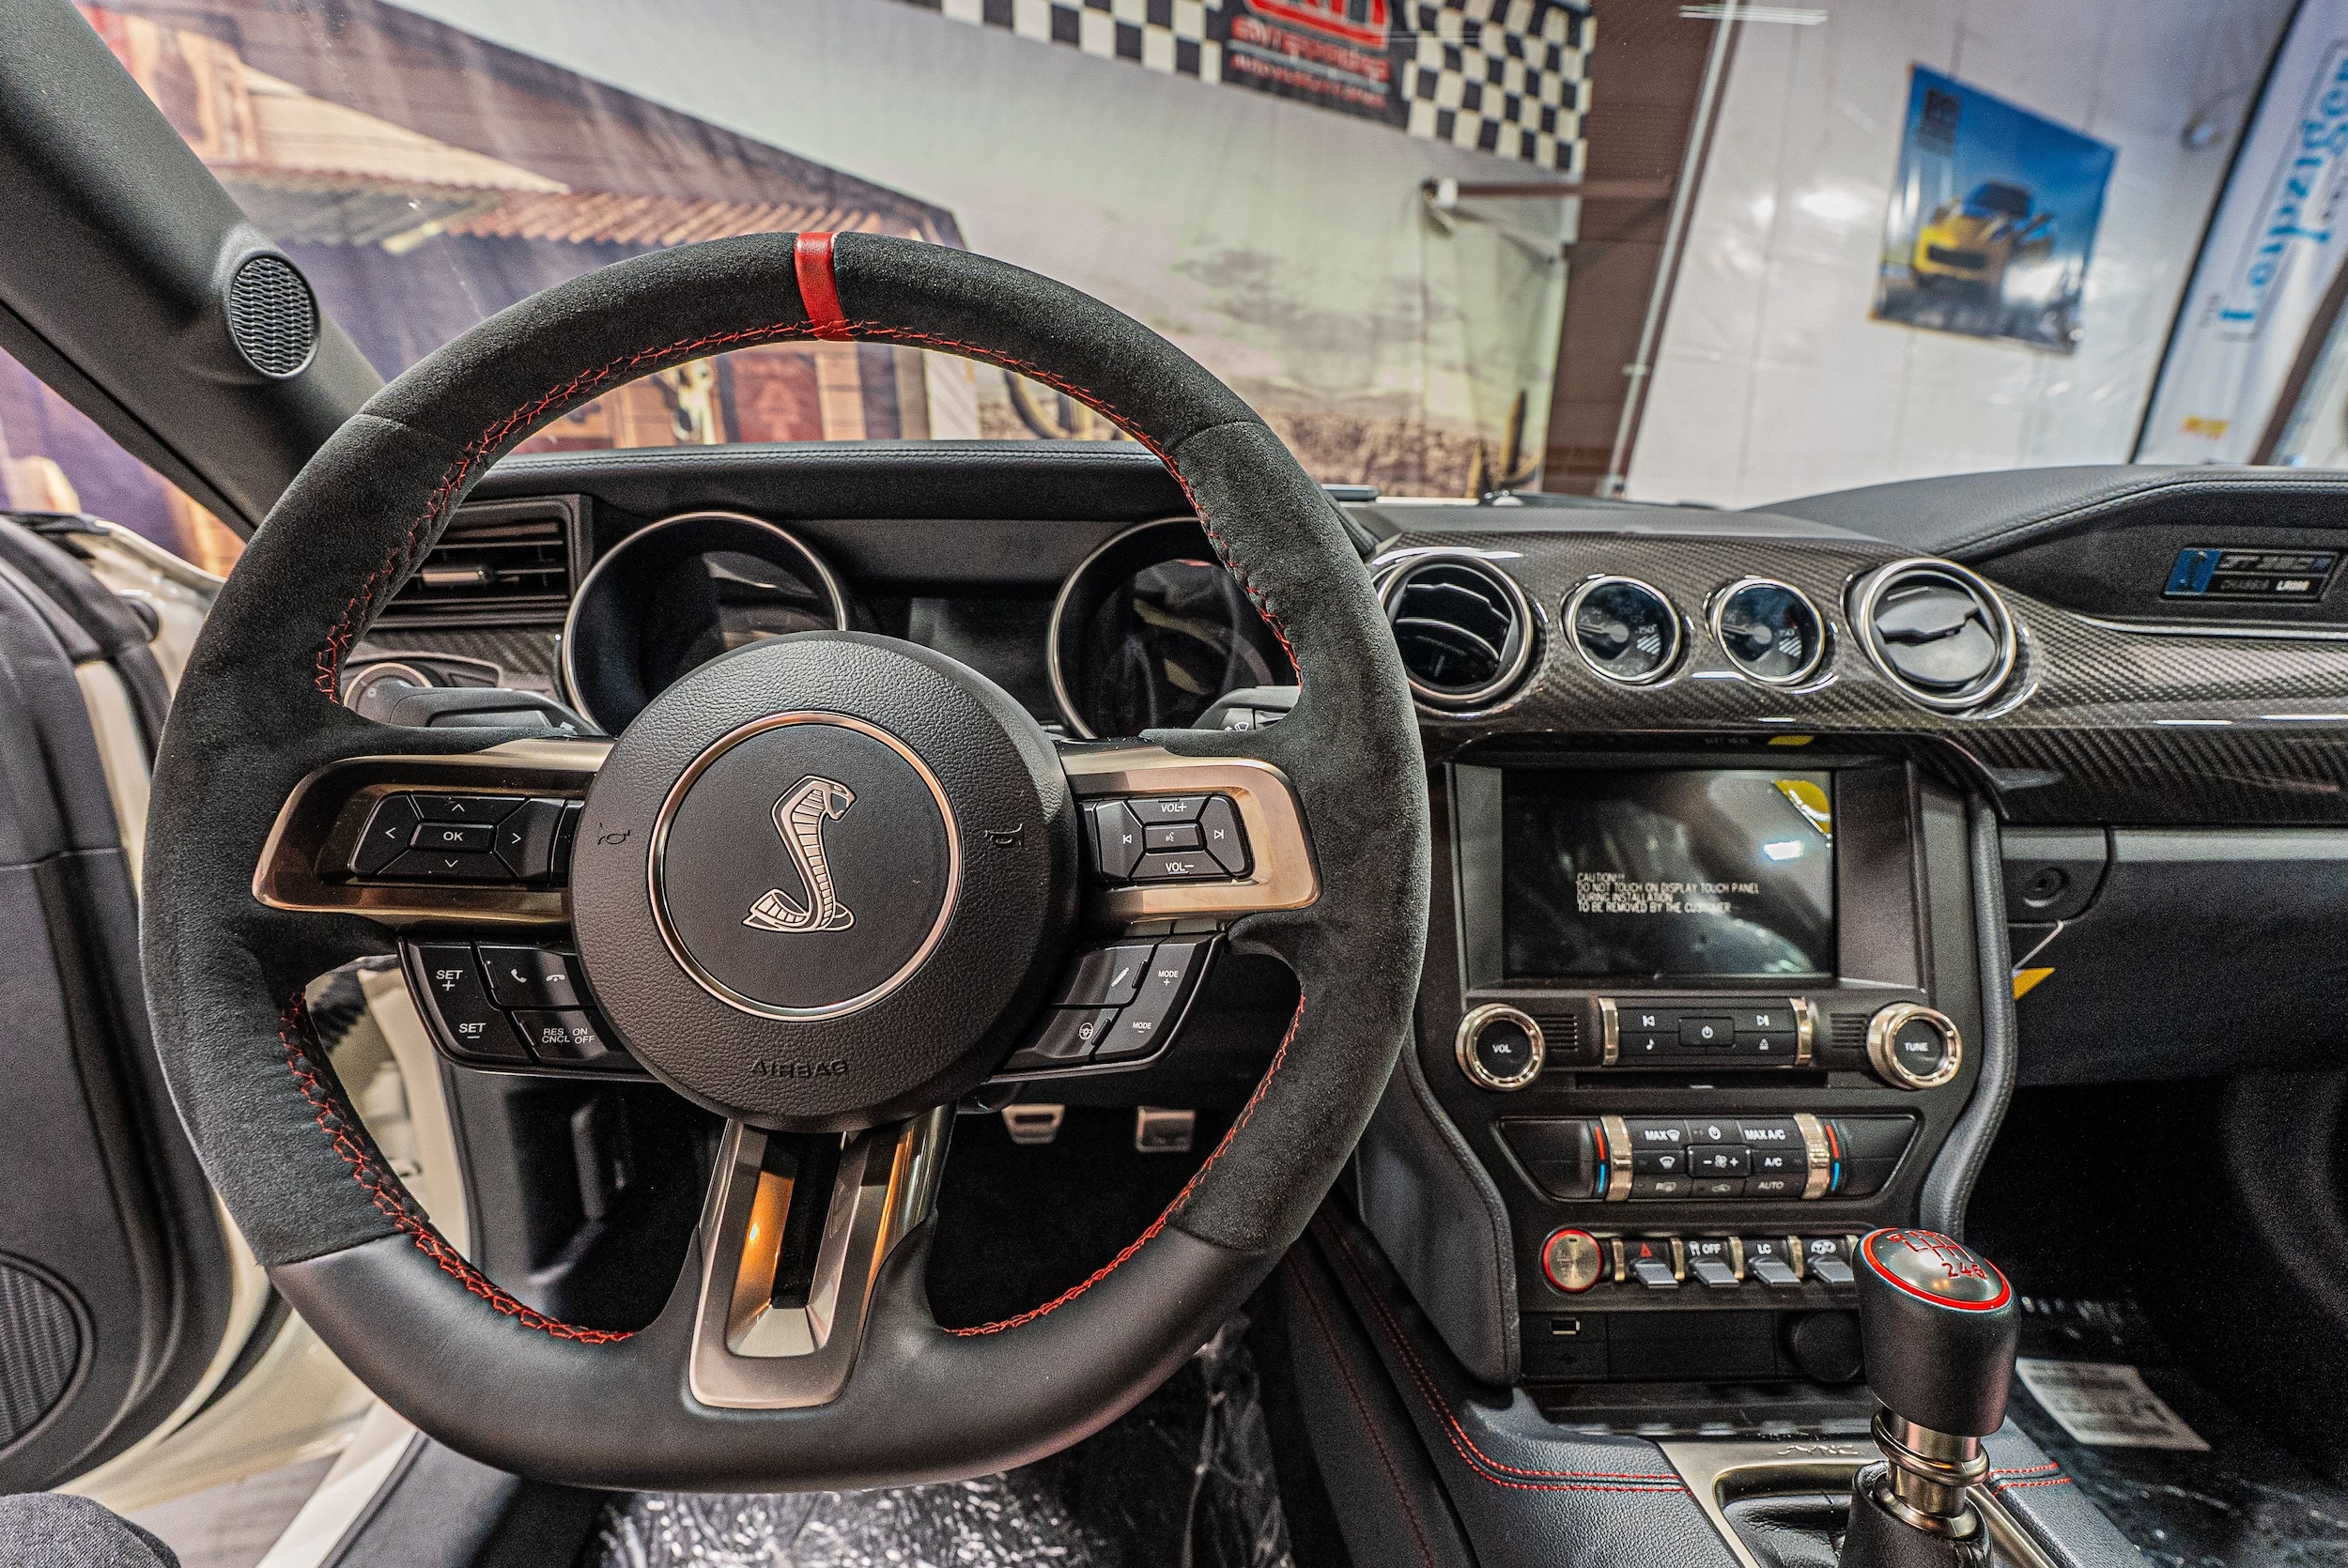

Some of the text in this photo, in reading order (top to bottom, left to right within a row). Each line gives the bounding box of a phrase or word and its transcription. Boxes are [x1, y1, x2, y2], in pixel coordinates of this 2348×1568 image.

[442, 831, 464, 842] OK
[1577, 883, 1760, 894] DO NOT TOUCH ON DISPLAY TOUCH PANEL
[1577, 892, 1674, 902] DURING INSTALLATION
[1578, 901, 1591, 913] TO
[1591, 901, 1605, 913] BE
[1606, 901, 1648, 913] REMOVED
[1649, 901, 1662, 913] BY
[1665, 901, 1683, 914] THE
[435, 969, 464, 980] SET
[1157, 970, 1180, 978] MODE
[458, 1022, 487, 1034] SET
[1132, 1021, 1152, 1030] MODE
[543, 1027, 588, 1036] RES ON
[541, 1035, 595, 1045] CNCL OFF
[1491, 1043, 1512, 1053] VOL
[1903, 1041, 1929, 1053] TUNE
[750, 1056, 849, 1079] AIRBAG
[1645, 1130, 1668, 1141] MAX
[1744, 1129, 1786, 1141] MAX A/C
[1764, 1157, 1783, 1167] A/C
[1757, 1180, 1784, 1191] AUTO
[1702, 1242, 1722, 1254] OFF
[1756, 1243, 1772, 1254] LC
